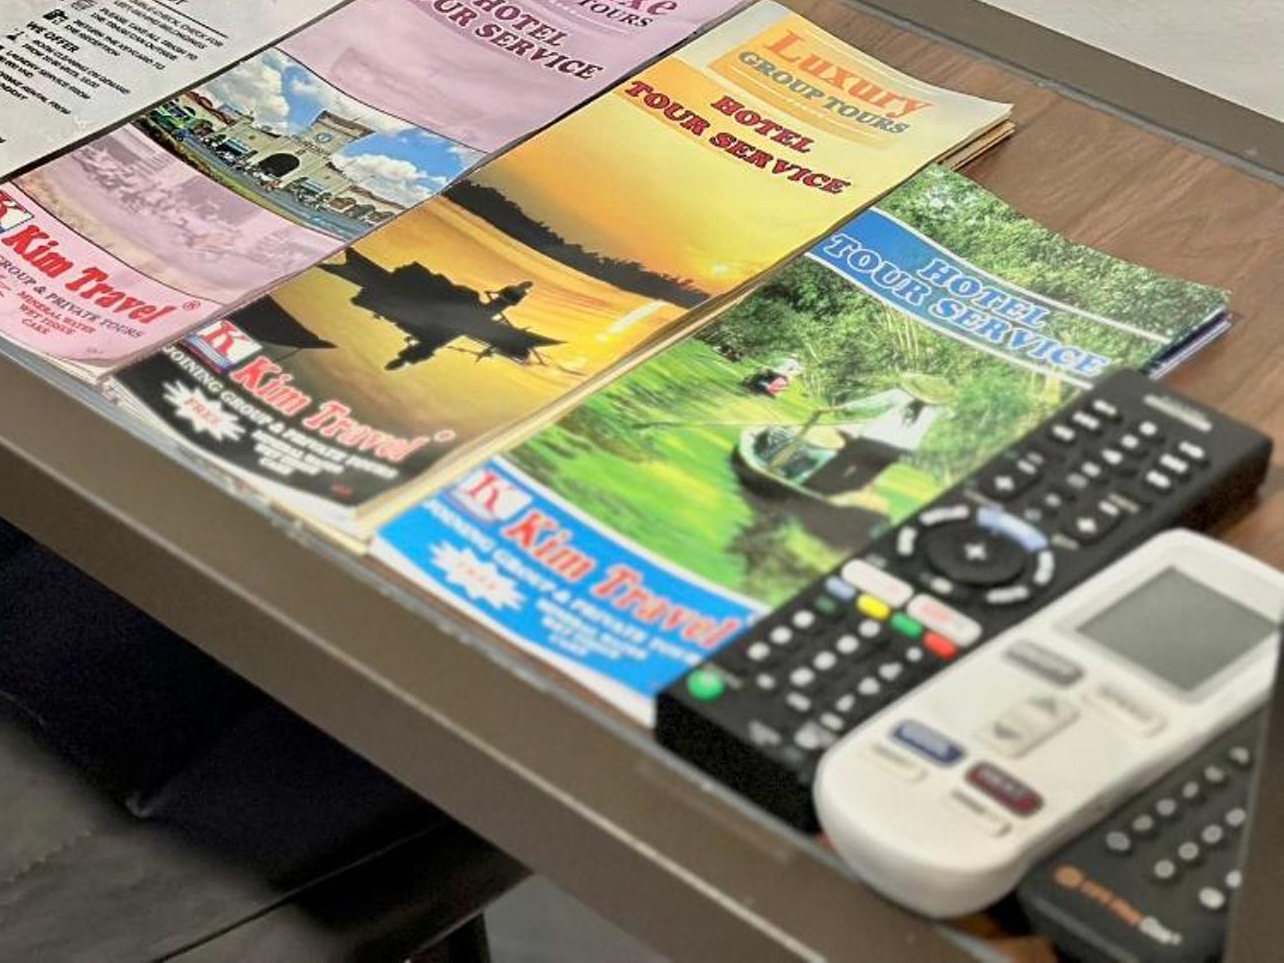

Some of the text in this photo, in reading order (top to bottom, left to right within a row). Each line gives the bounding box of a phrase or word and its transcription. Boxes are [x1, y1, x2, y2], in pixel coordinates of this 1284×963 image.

[41, 31, 80, 52] OFFER
[475, 22, 604, 80] SERVICE
[764, 30, 934, 118] Luxury
[711, 95, 815, 153] HOTEL
[738, 51, 910, 135] GROUP TOURS
[624, 80, 851, 195] TOUR SERVICE
[1, 225, 177, 325] Kim Travel
[17, 290, 63, 323] MINERAL
[33, 284, 46, 296] &
[47, 292, 100, 325] PRIVATE
[825, 233, 1110, 376] TOUR SERVICE
[920, 258, 1050, 327] HOTEL
[206, 320, 249, 356] K
[163, 344, 223, 394] JOINING
[220, 390, 274, 429] GROUP
[230, 356, 430, 463] Kim Travel
[500, 509, 598, 582] Kim
[591, 563, 741, 648] Travel
